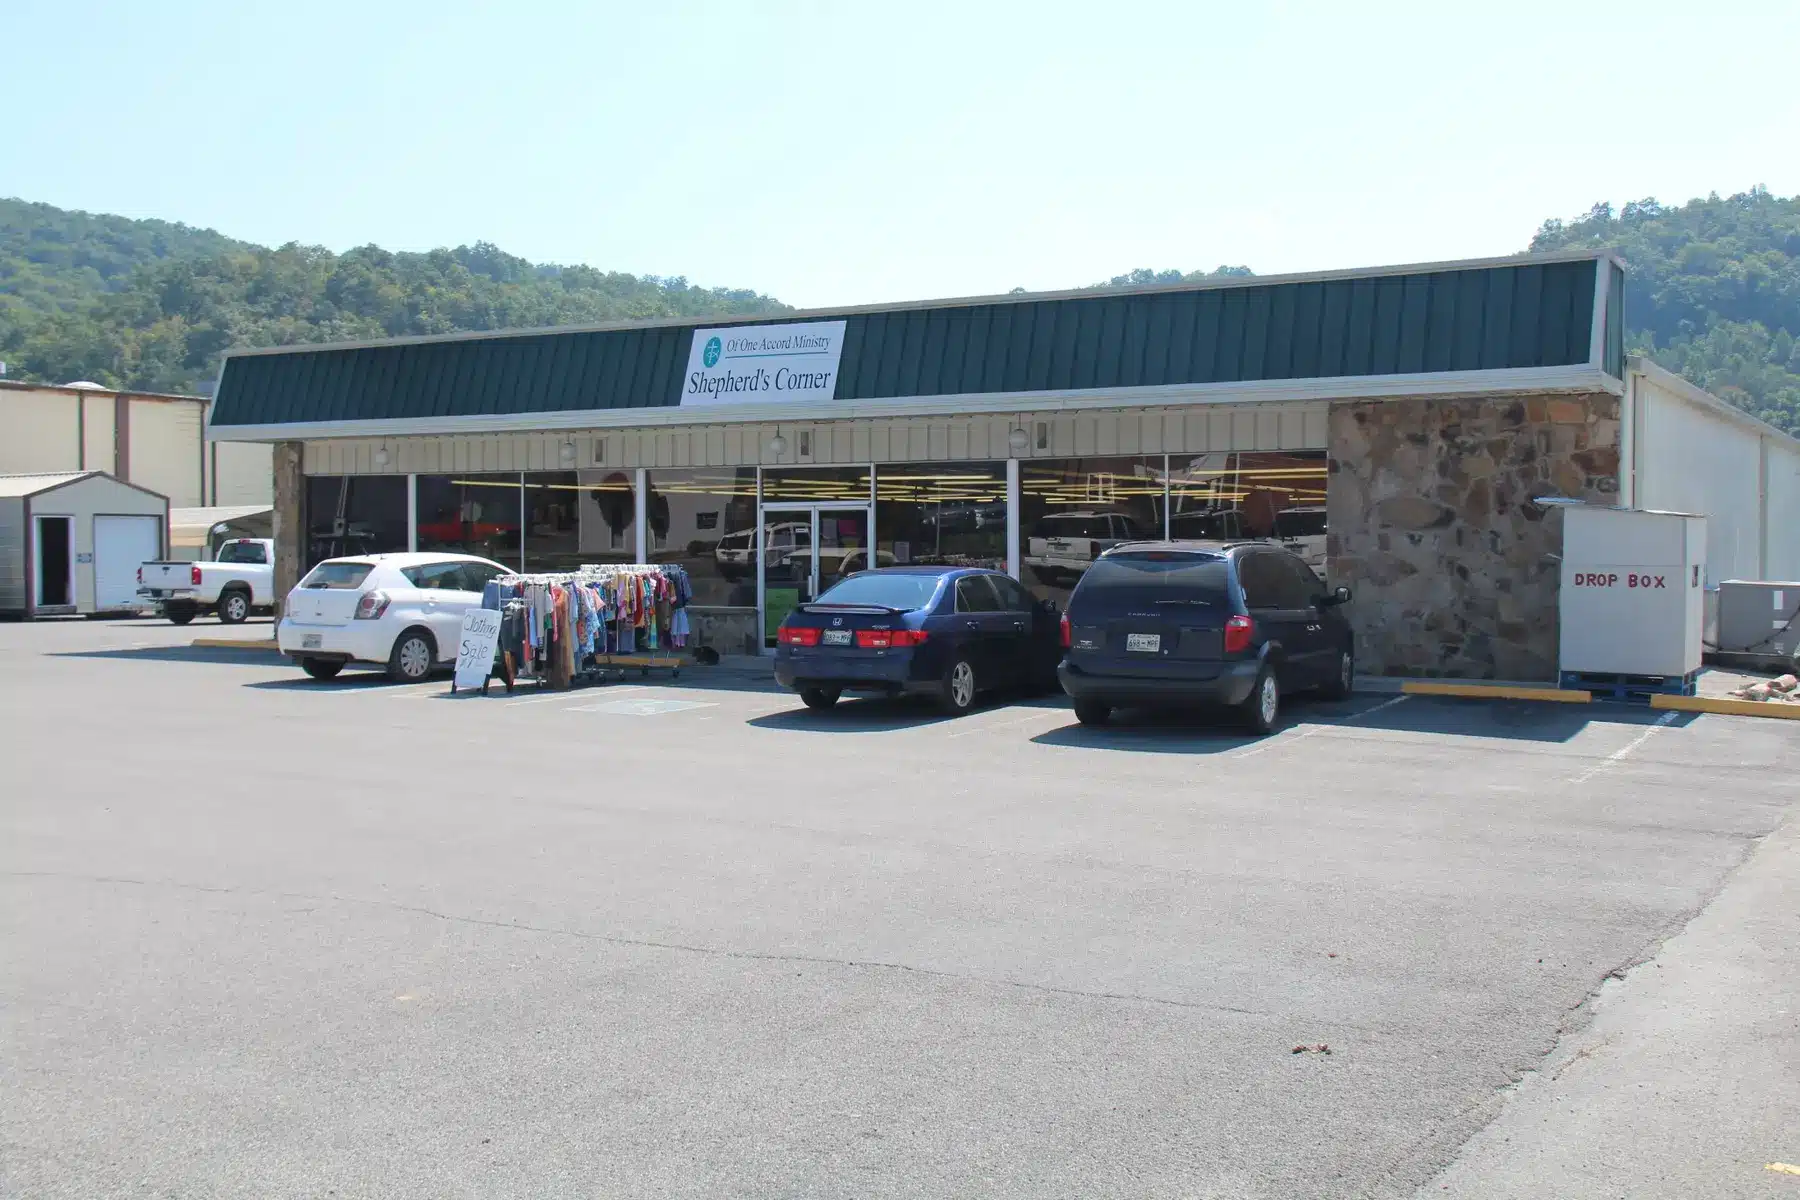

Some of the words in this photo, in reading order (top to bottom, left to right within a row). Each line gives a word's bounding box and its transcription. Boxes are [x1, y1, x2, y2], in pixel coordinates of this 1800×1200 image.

[726, 338, 740, 352] Of
[740, 337, 758, 351] One
[759, 335, 791, 350] Accord
[793, 334, 831, 350] Ministry
[688, 369, 770, 399] Shepherd's
[775, 367, 831, 391] Corner
[1575, 573, 1618, 587] DROP
[1628, 574, 1666, 588] BOX
[460, 639, 488, 659] Sale
